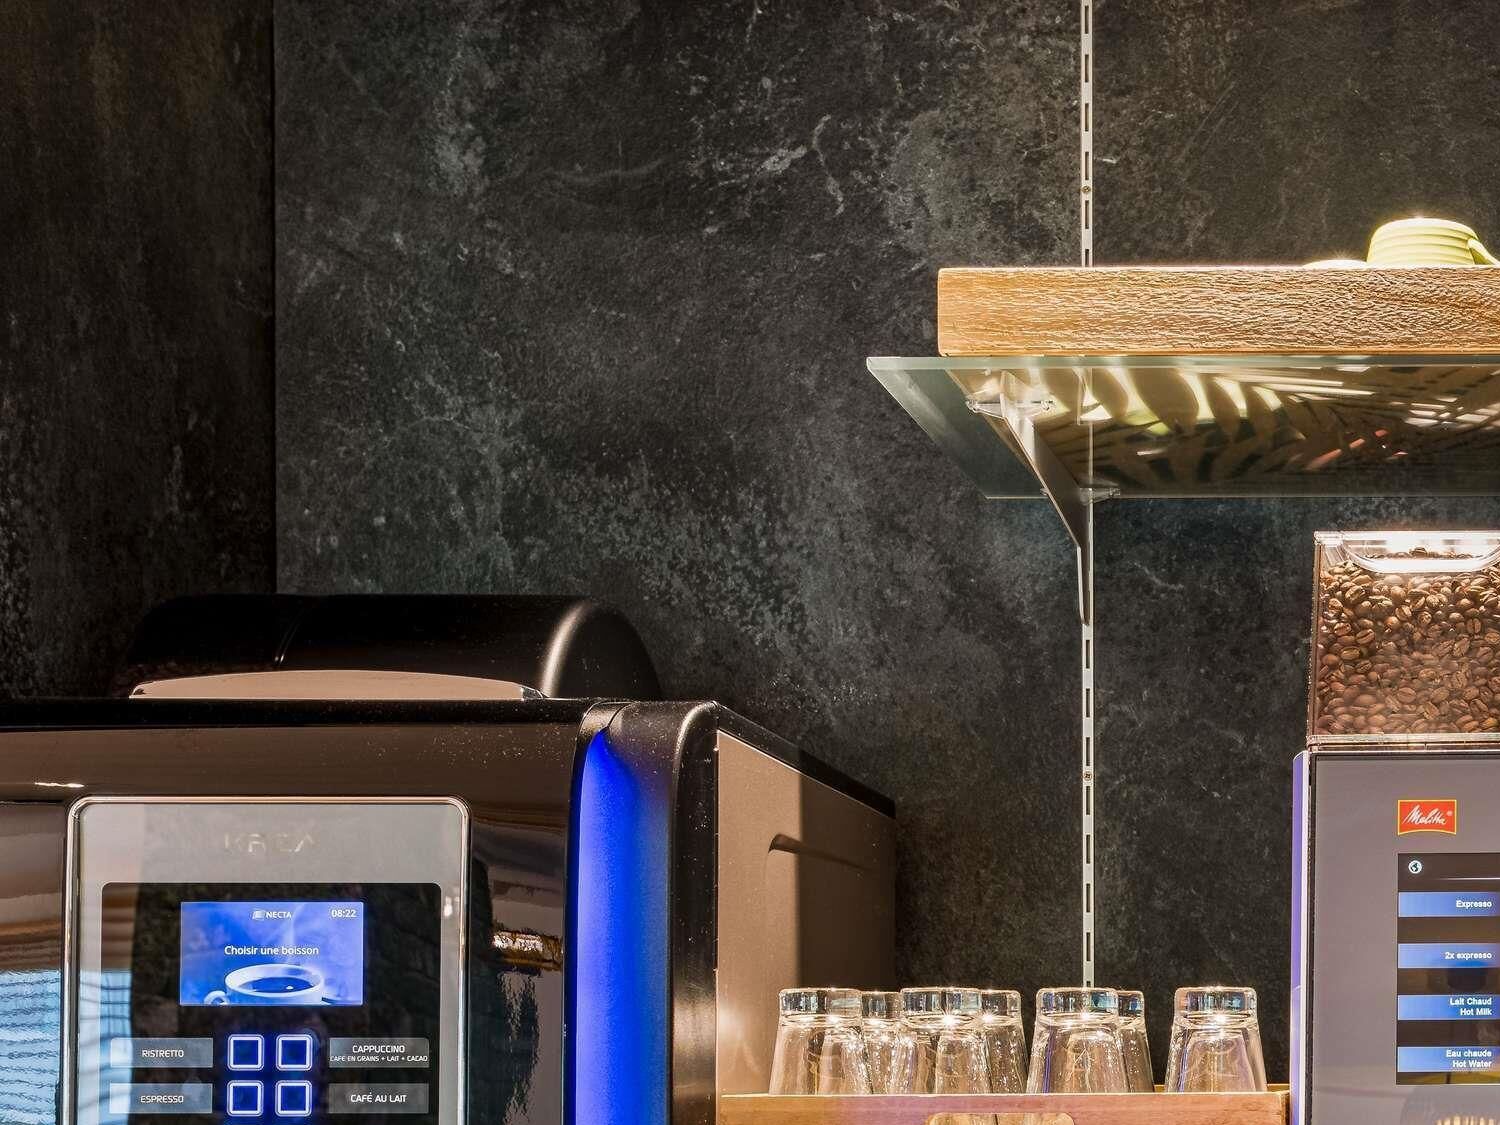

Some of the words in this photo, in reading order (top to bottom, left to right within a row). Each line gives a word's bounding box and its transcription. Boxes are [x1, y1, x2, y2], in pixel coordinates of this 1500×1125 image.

[1402, 804, 1447, 825] Melitta
[1456, 900, 1492, 909] Expresso
[266, 911, 292, 919] NECTA
[331, 909, 357, 919] 08:22
[224, 945, 258, 956] Choisir
[260, 947, 280, 956] une
[281, 945, 319, 956] boisson
[1445, 951, 1455, 959] 2x
[1456, 952, 1492, 961] expresso
[1466, 997, 1492, 1005] Chaud
[1460, 1008, 1474, 1016] Hot
[1476, 1008, 1493, 1016] Milk
[352, 1045, 406, 1053] CAPPUCCINO
[1463, 1049, 1492, 1057] chaude
[141, 1049, 185, 1058] RISTRETTO
[1452, 1060, 1467, 1068] Hot
[1468, 1060, 1492, 1068] Water
[140, 1095, 184, 1103] ESPRESSO
[350, 1091, 373, 1103] CAFÉ
[374, 1094, 388, 1103] AU
[389, 1094, 407, 1103] LAIT
